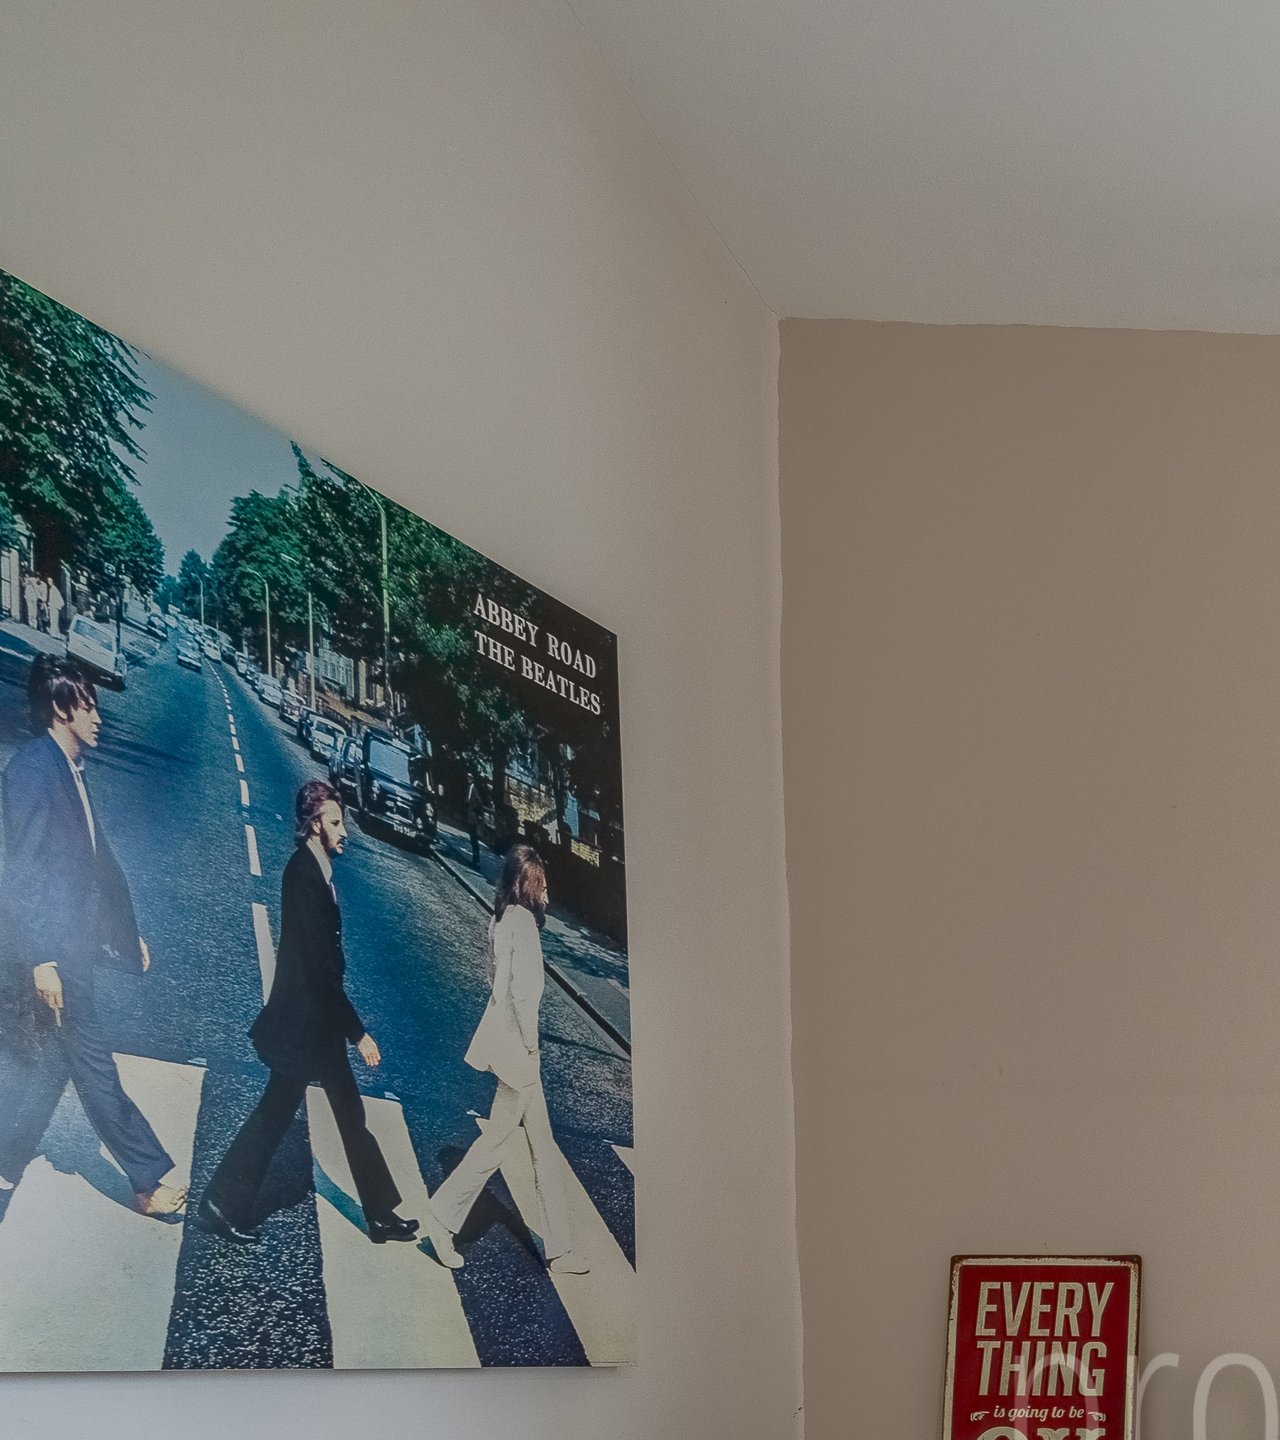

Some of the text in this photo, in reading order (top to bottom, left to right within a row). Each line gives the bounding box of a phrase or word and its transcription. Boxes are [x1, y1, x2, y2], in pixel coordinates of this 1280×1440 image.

[473, 593, 597, 679] ABBEY ROAD
[474, 630, 601, 716] THE BEATLES
[975, 1281, 1115, 1337] EVERY
[977, 1341, 1108, 1397] THING
[993, 1405, 1085, 1422] is going to be
